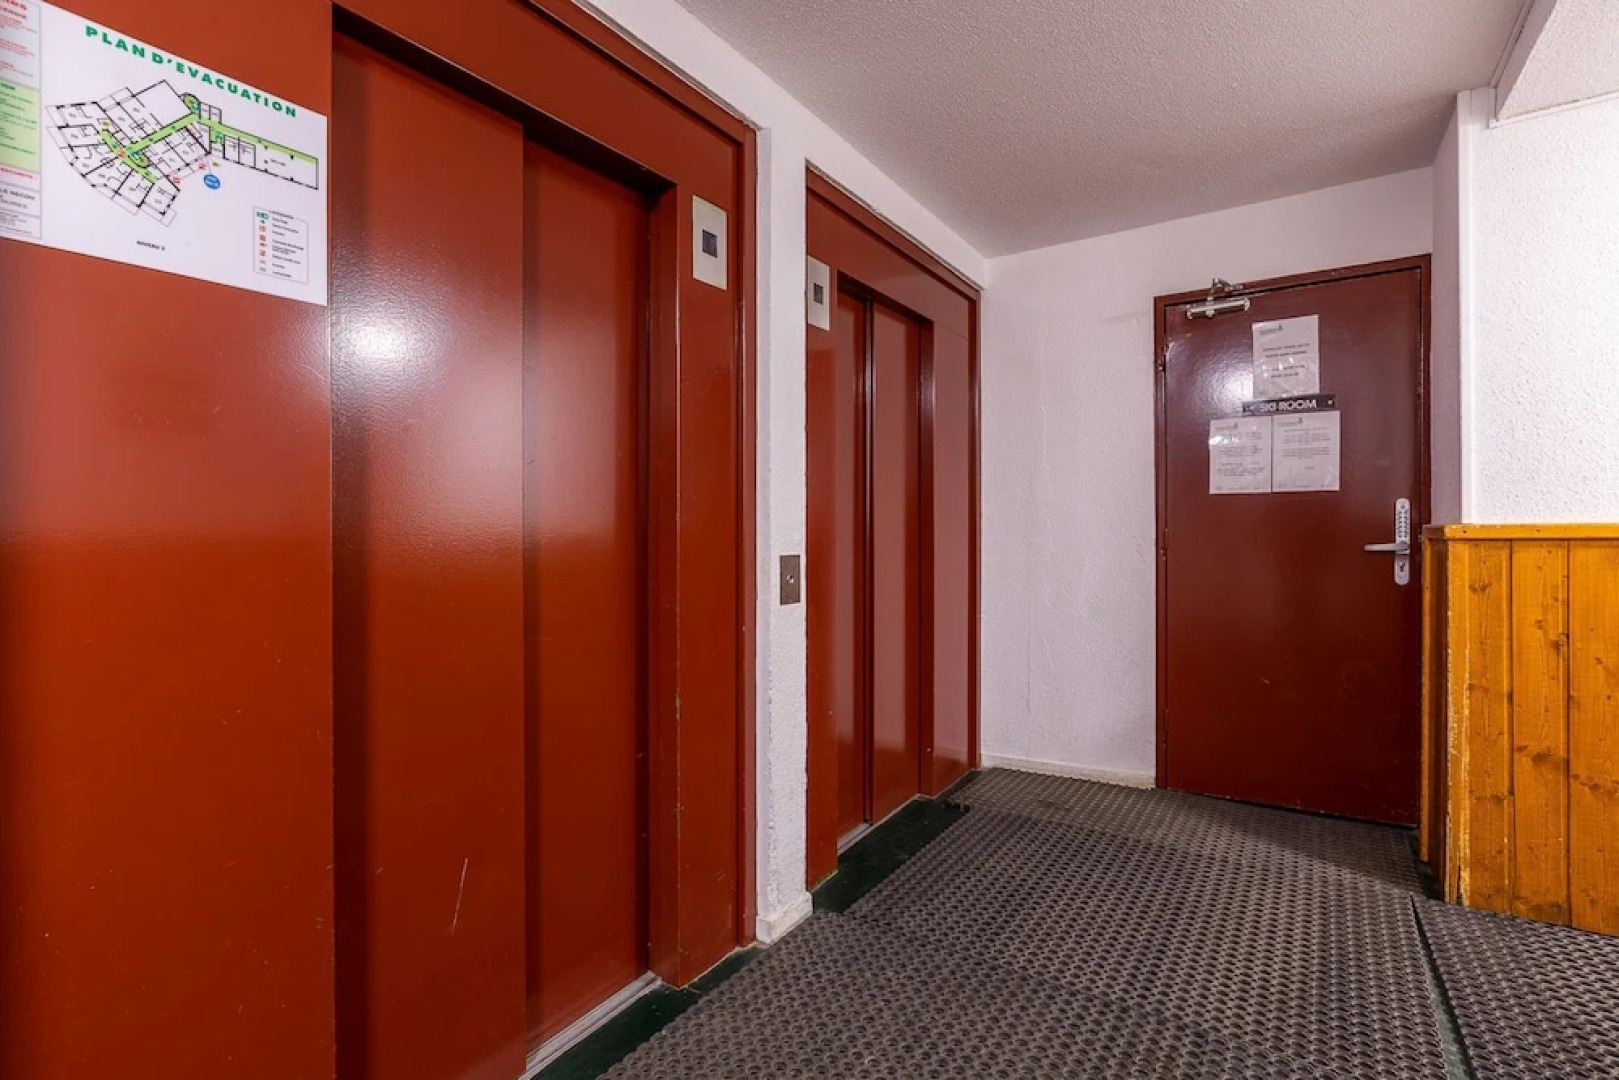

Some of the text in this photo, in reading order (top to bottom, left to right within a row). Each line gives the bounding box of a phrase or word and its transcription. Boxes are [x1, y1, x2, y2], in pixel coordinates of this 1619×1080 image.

[85, 25, 145, 59] PLAN
[1259, 399, 1317, 412] SKI ROOM
